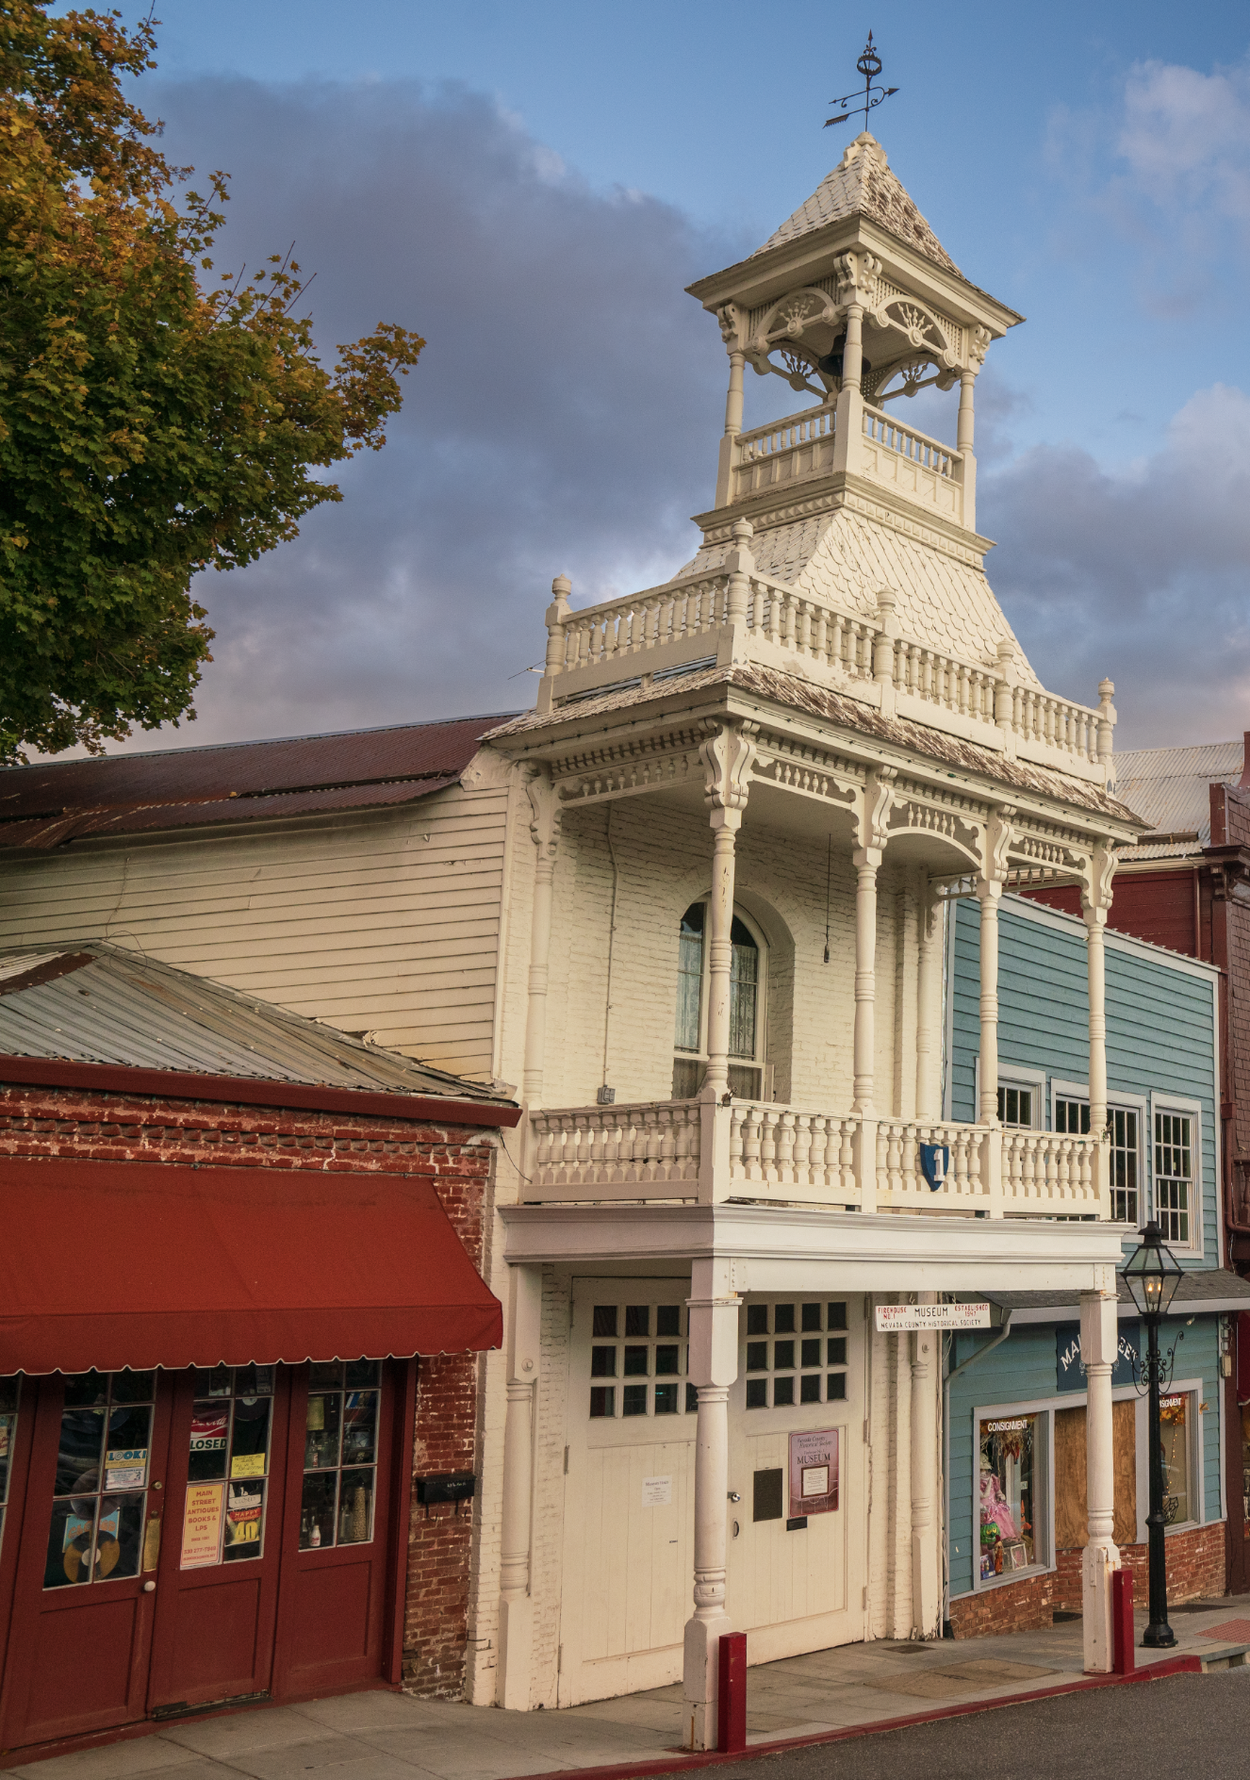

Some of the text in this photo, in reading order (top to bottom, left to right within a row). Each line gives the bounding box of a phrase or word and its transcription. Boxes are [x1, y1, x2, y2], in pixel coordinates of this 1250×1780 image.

[934, 1149, 945, 1181] 1
[878, 1306, 907, 1314] FIREHOUSE
[915, 1307, 949, 1317] MUSEUM
[954, 1304, 988, 1312] ESTABLISHED
[1117, 1336, 1139, 1362] EET
[1159, 1397, 1181, 1408] SIGNMENT
[987, 1419, 1028, 1432] CONSIGNMENT
[190, 1439, 227, 1450] LOSED
[797, 1453, 831, 1464] MUSEUM
[191, 1498, 216, 1506] STREET
[187, 1506, 219, 1515] ANTIQUES
[234, 1509, 258, 1518] HAPPY
[68, 1519, 116, 1539] CLOED
[234, 1521, 258, 1541] 40
